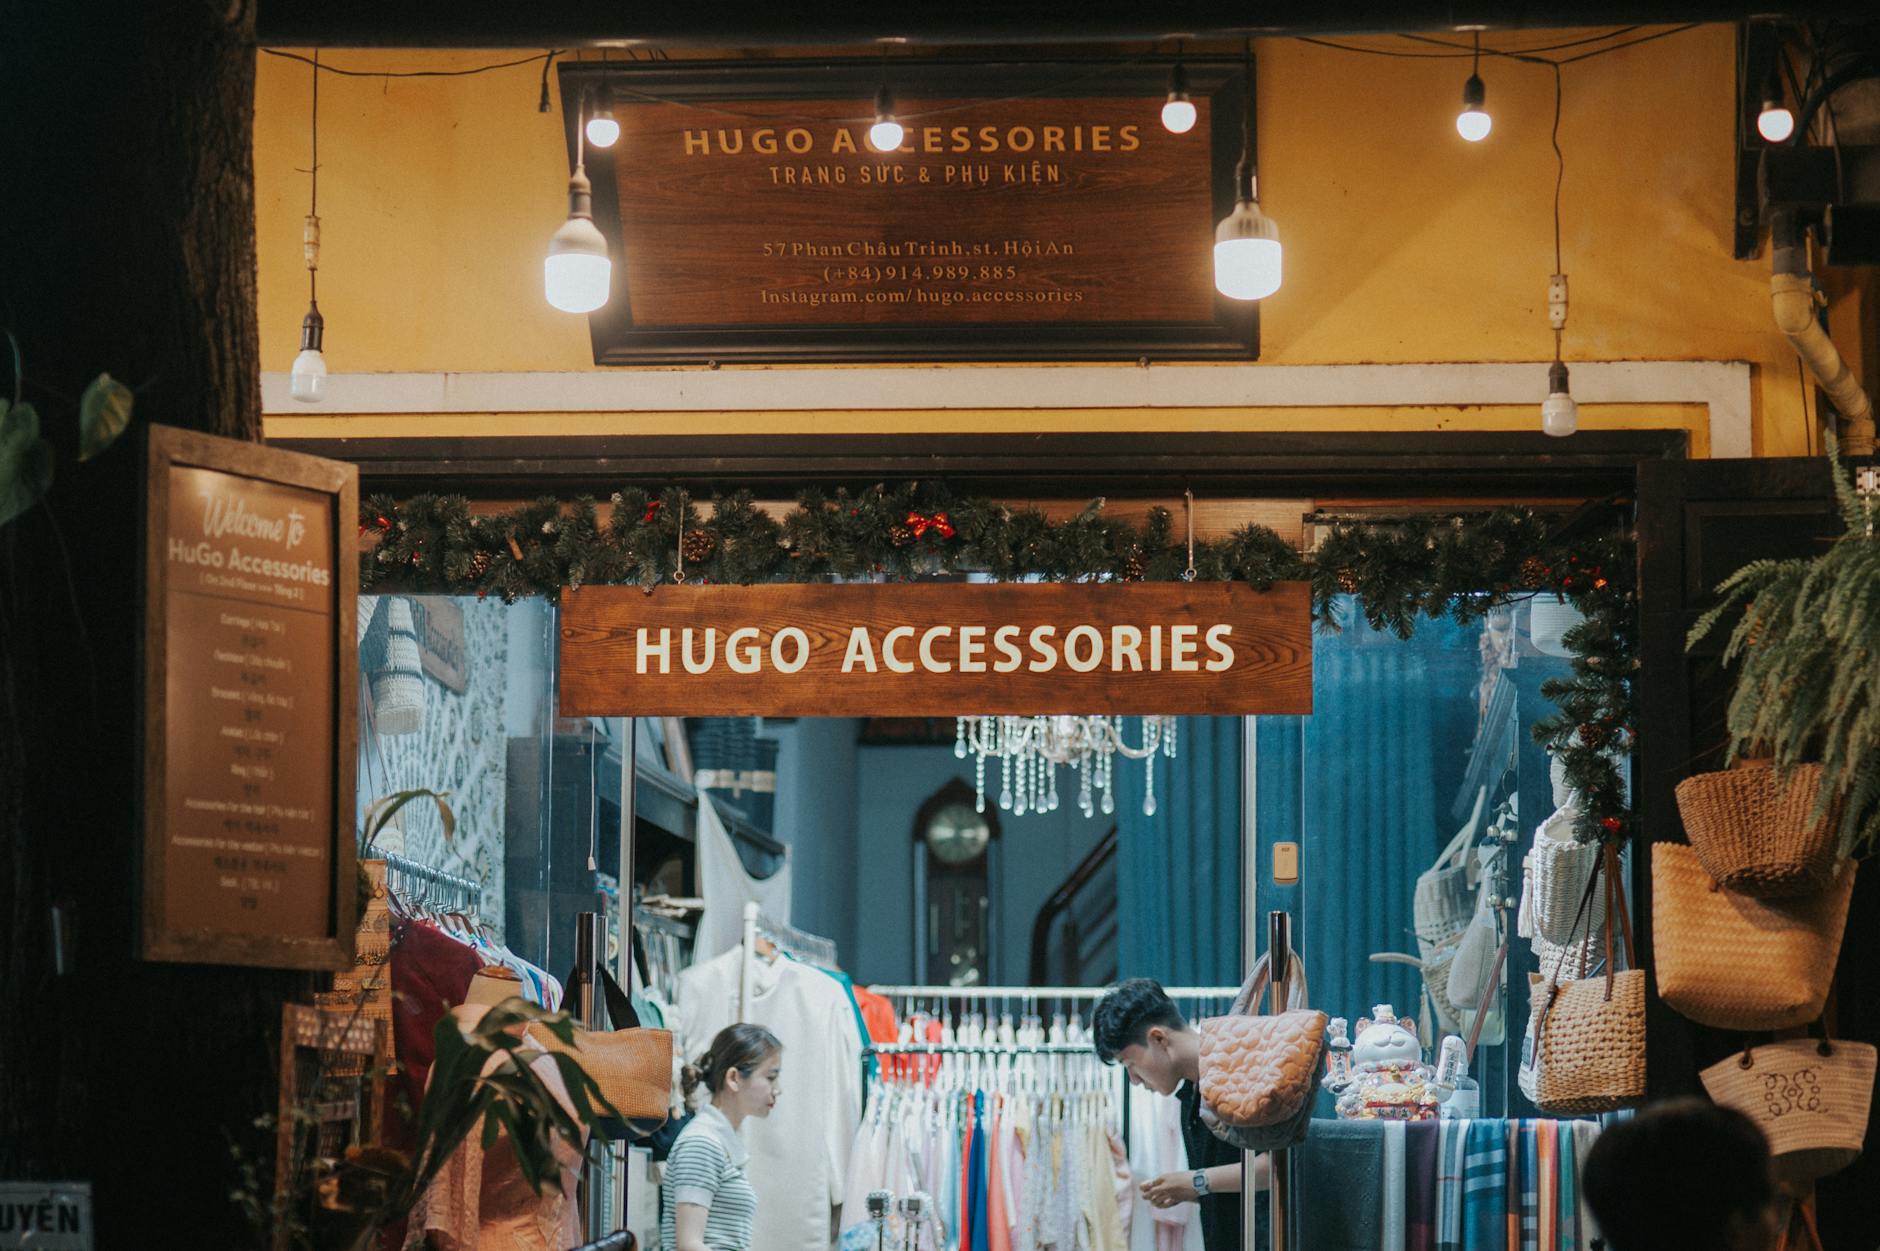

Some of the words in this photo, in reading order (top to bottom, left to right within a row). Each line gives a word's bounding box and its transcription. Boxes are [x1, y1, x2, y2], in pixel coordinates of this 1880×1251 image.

[684, 128, 814, 155] HUGO
[769, 165, 846, 184] TRANG
[919, 167, 930, 183] &
[763, 242, 786, 257] 57
[792, 242, 842, 256] Phan
[200, 492, 284, 542] Welcome
[287, 507, 305, 550] to
[169, 538, 223, 567] HuGo
[228, 547, 330, 586] Accessories
[635, 626, 810, 675] HUGO
[841, 623, 1236, 674] ACCESSORIES
